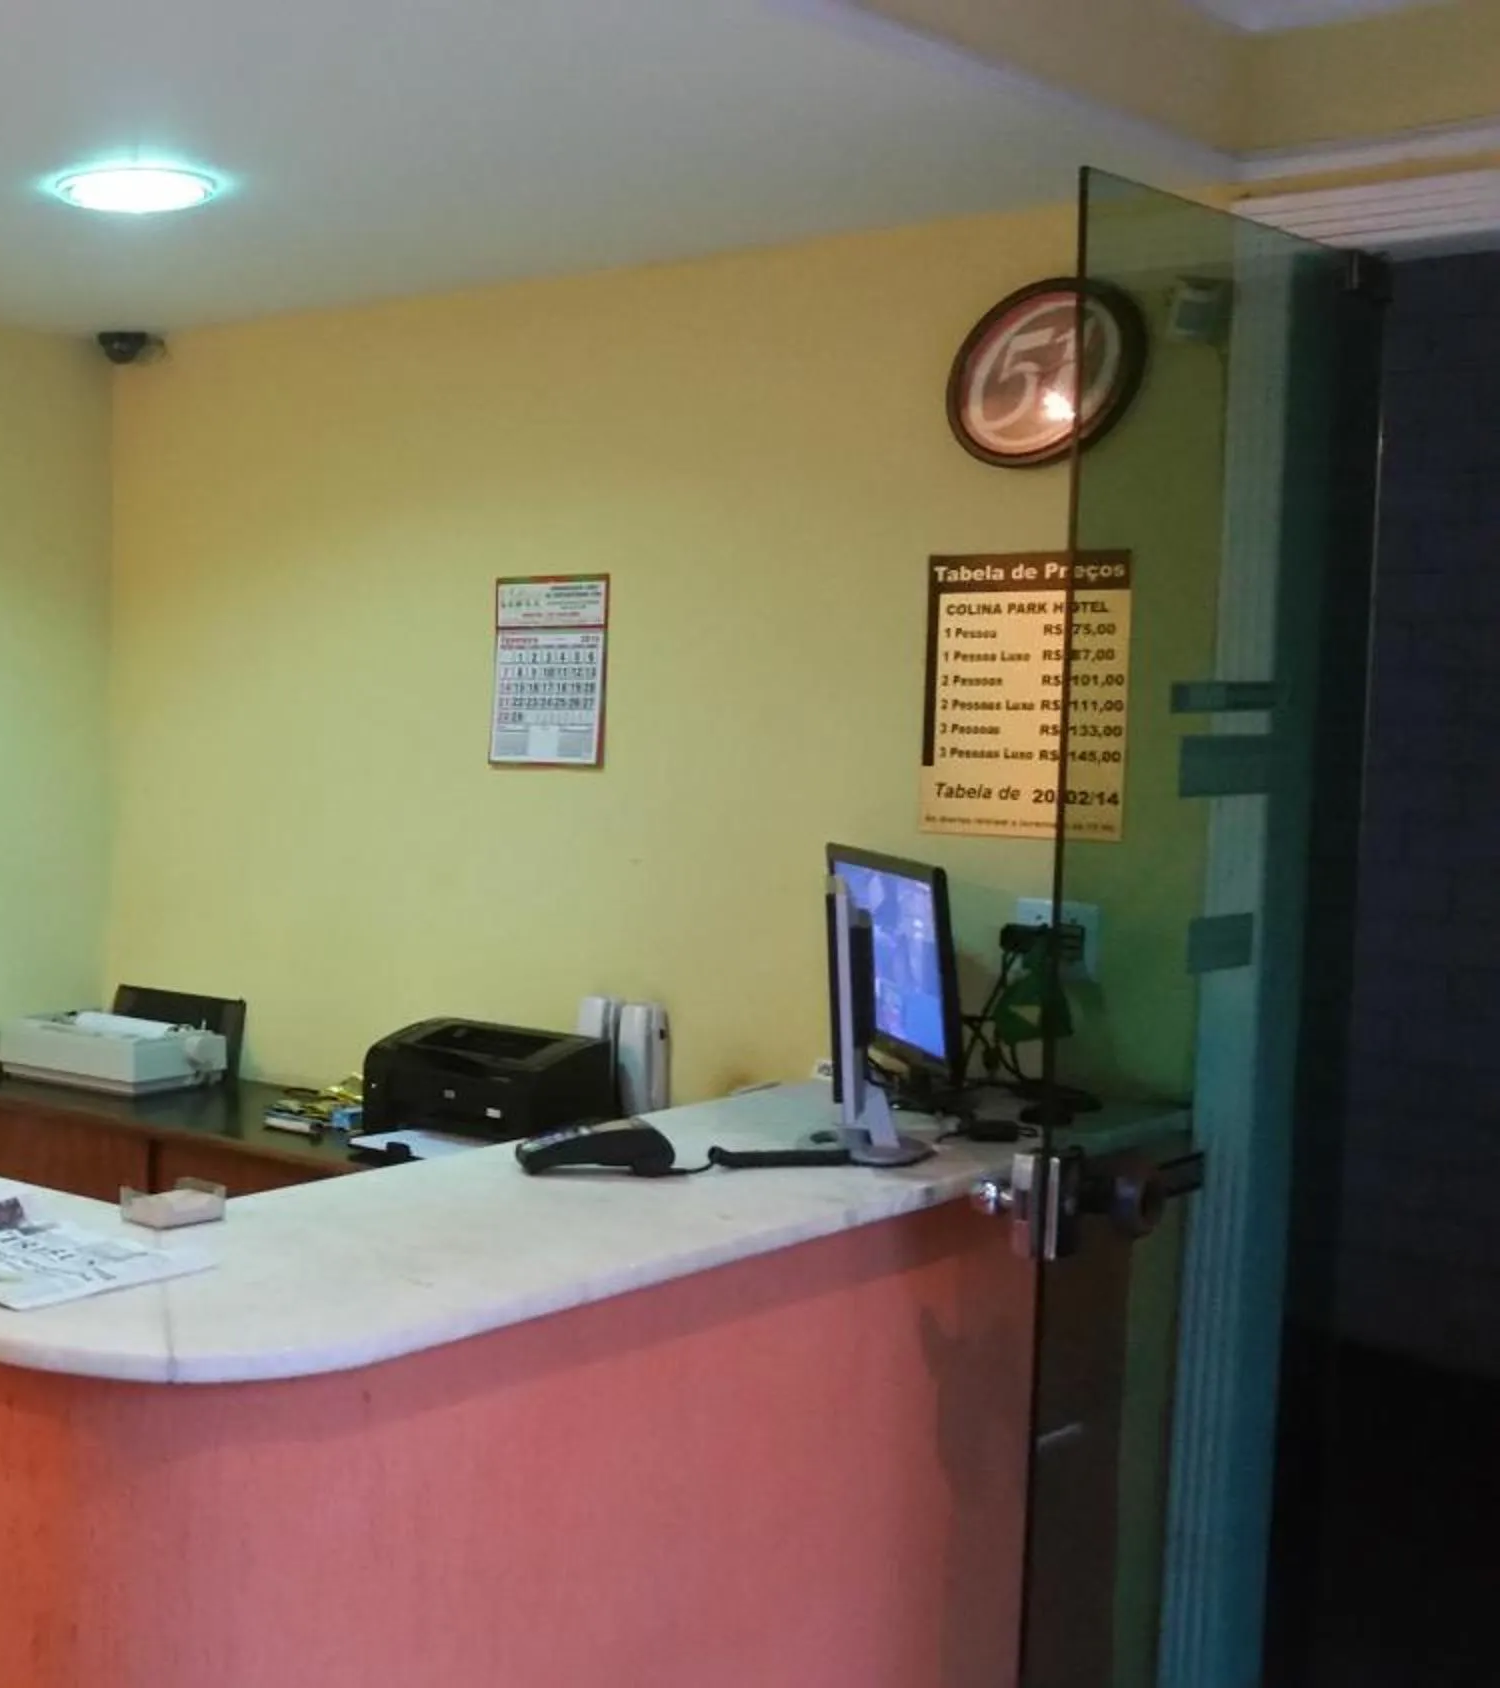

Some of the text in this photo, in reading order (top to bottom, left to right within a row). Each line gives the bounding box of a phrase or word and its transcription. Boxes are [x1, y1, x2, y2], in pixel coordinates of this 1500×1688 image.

[933, 562, 1125, 582] Tabela de Preços
[946, 603, 1002, 615] COLINA
[1007, 602, 1047, 614] PARK
[945, 628, 951, 638] 1
[956, 628, 997, 639] Pessoa
[1072, 623, 1116, 637] 75,00
[954, 650, 997, 662] Pessoa
[1001, 650, 1031, 662] Luxo
[941, 675, 949, 687] 2
[953, 675, 1003, 687] Pessoas
[1072, 674, 1125, 688] 101,00
[952, 699, 1002, 711] Pessoas
[1005, 700, 1035, 711] Luxo
[1070, 700, 1124, 713] 111,00
[951, 723, 1000, 735] Pessoas
[1069, 725, 1123, 738] 133,00
[950, 747, 1000, 759] Pessoas
[1003, 748, 1034, 760] Luxo
[1069, 750, 1122, 764] 145,00
[935, 782, 1119, 806] Tabela de 2002/14
